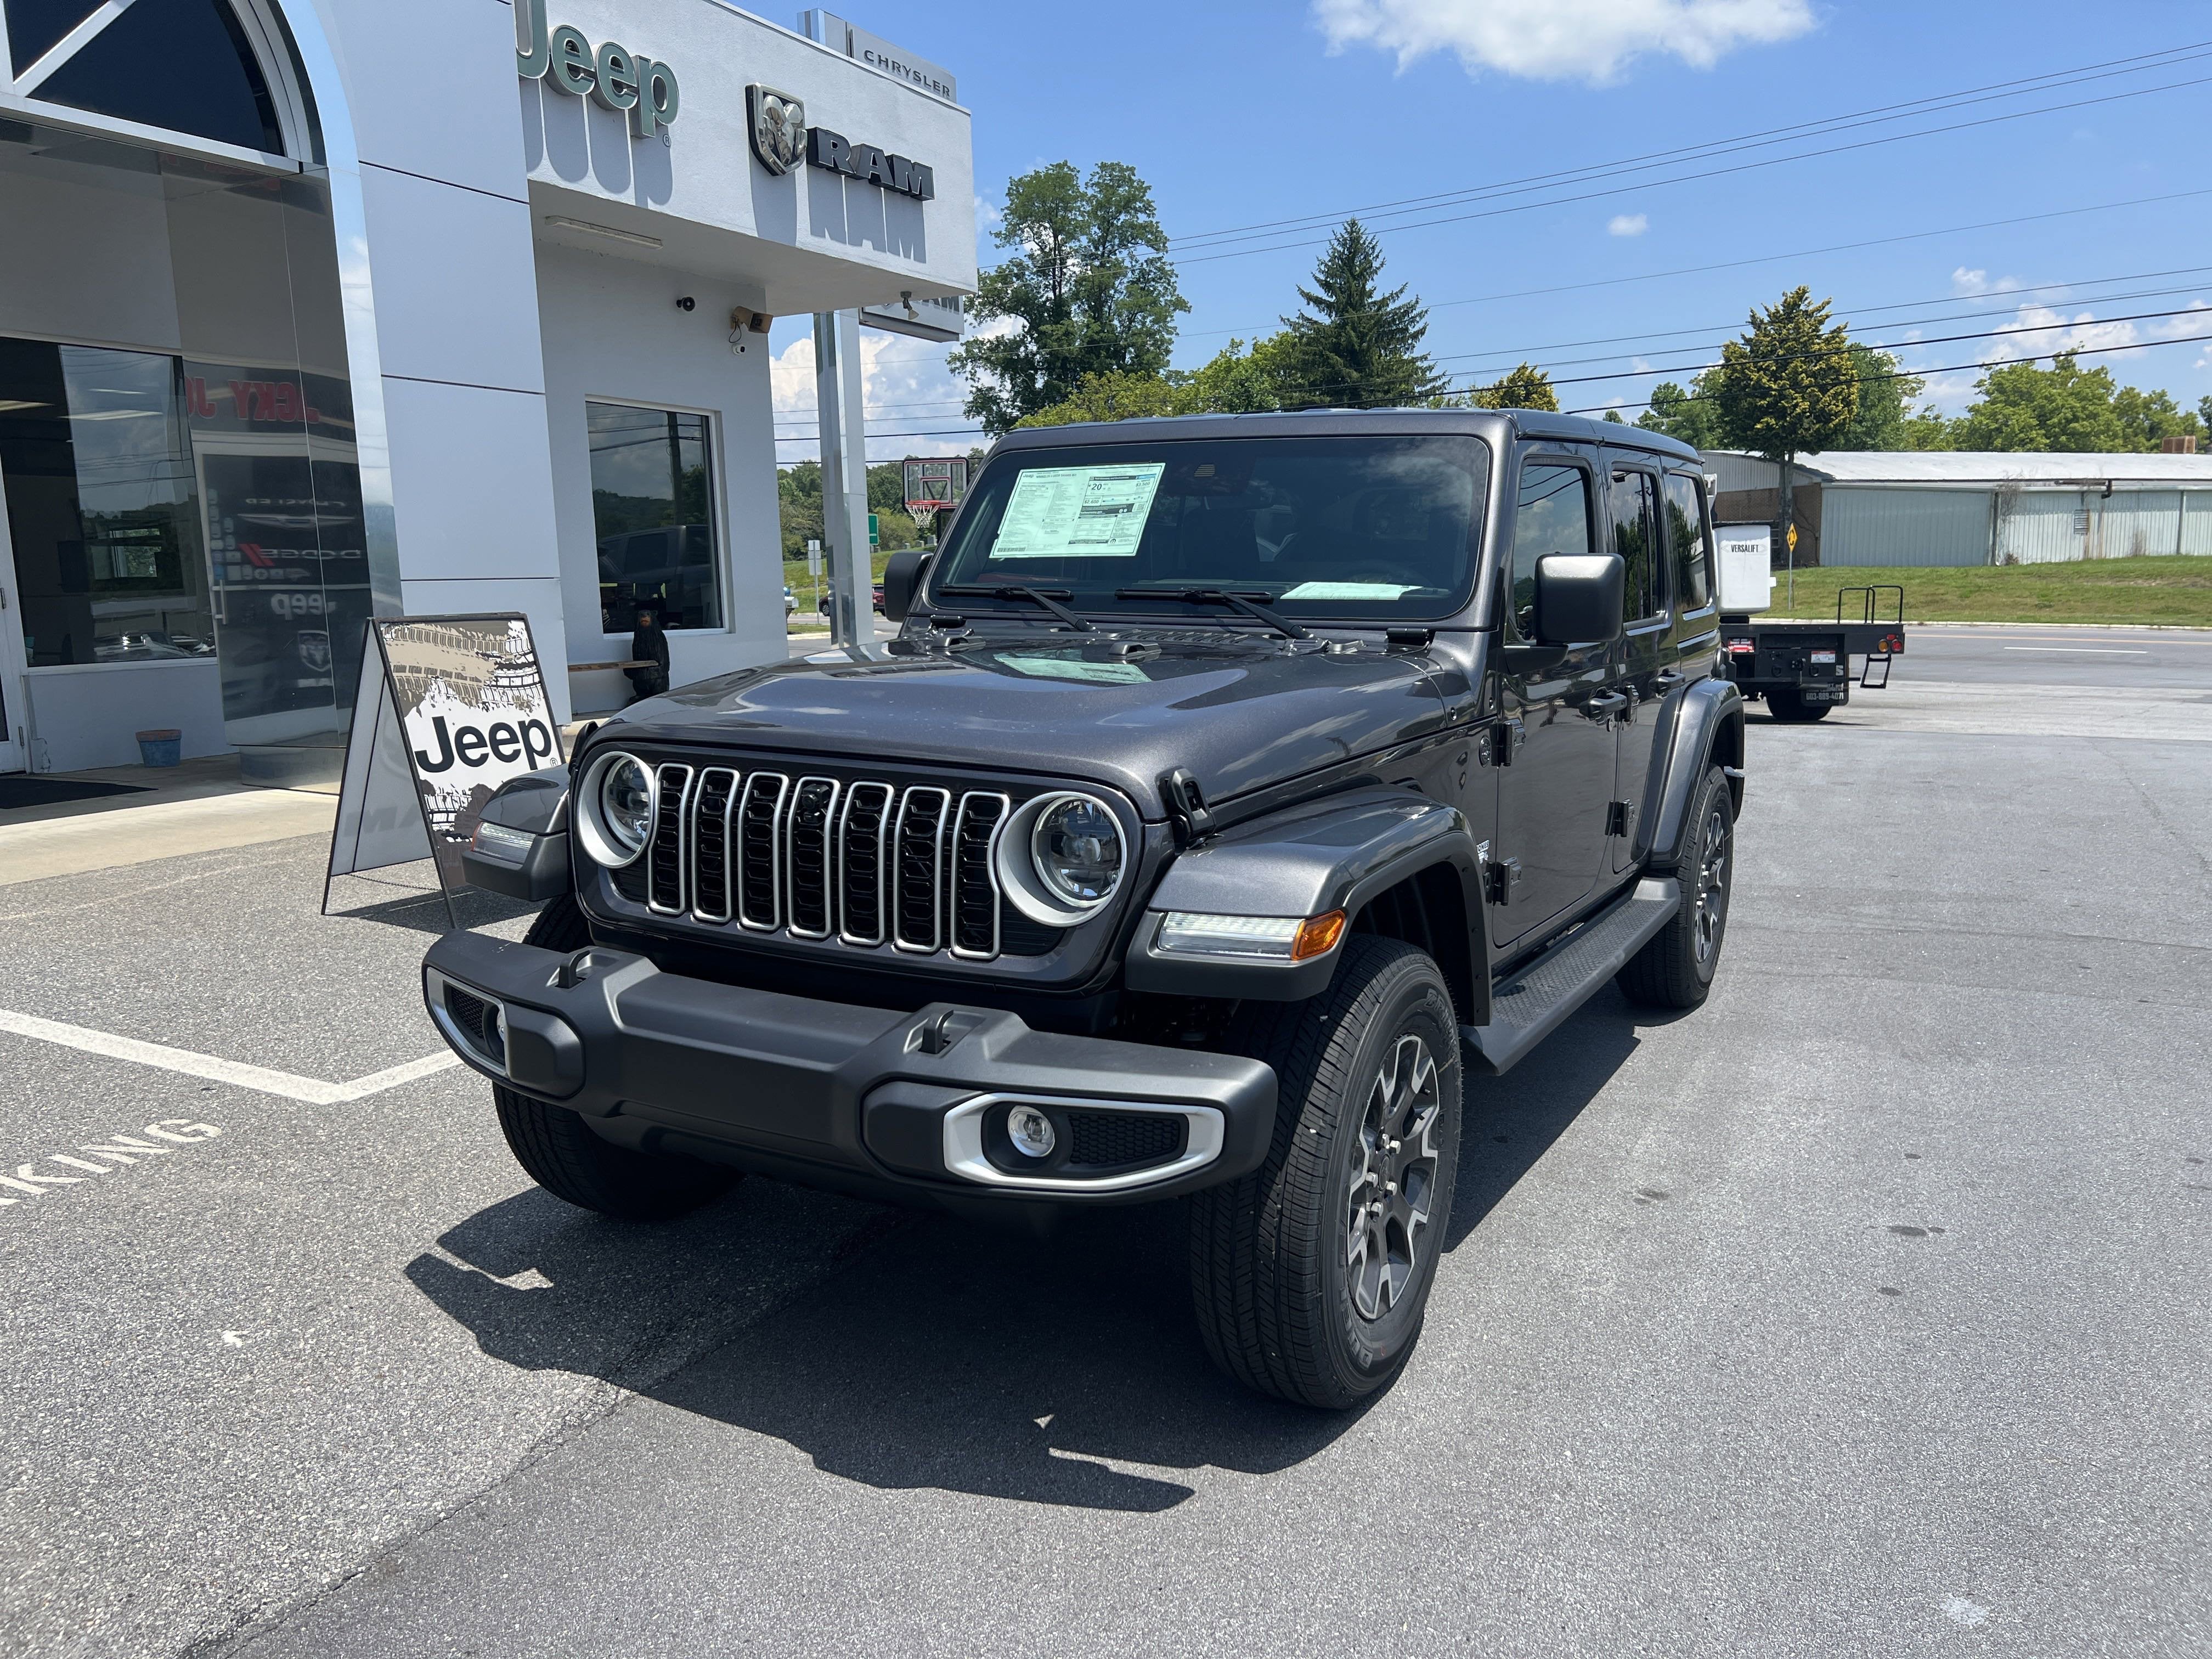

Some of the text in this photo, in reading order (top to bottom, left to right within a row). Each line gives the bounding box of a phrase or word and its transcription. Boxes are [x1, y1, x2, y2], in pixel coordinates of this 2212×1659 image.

[864, 49, 950, 98] CHRYSLER
[807, 127, 935, 201] RAM
[1731, 544, 1759, 553] VERSALIFT
[414, 715, 552, 773] Jeep
[0, 1119, 221, 1206] KING
